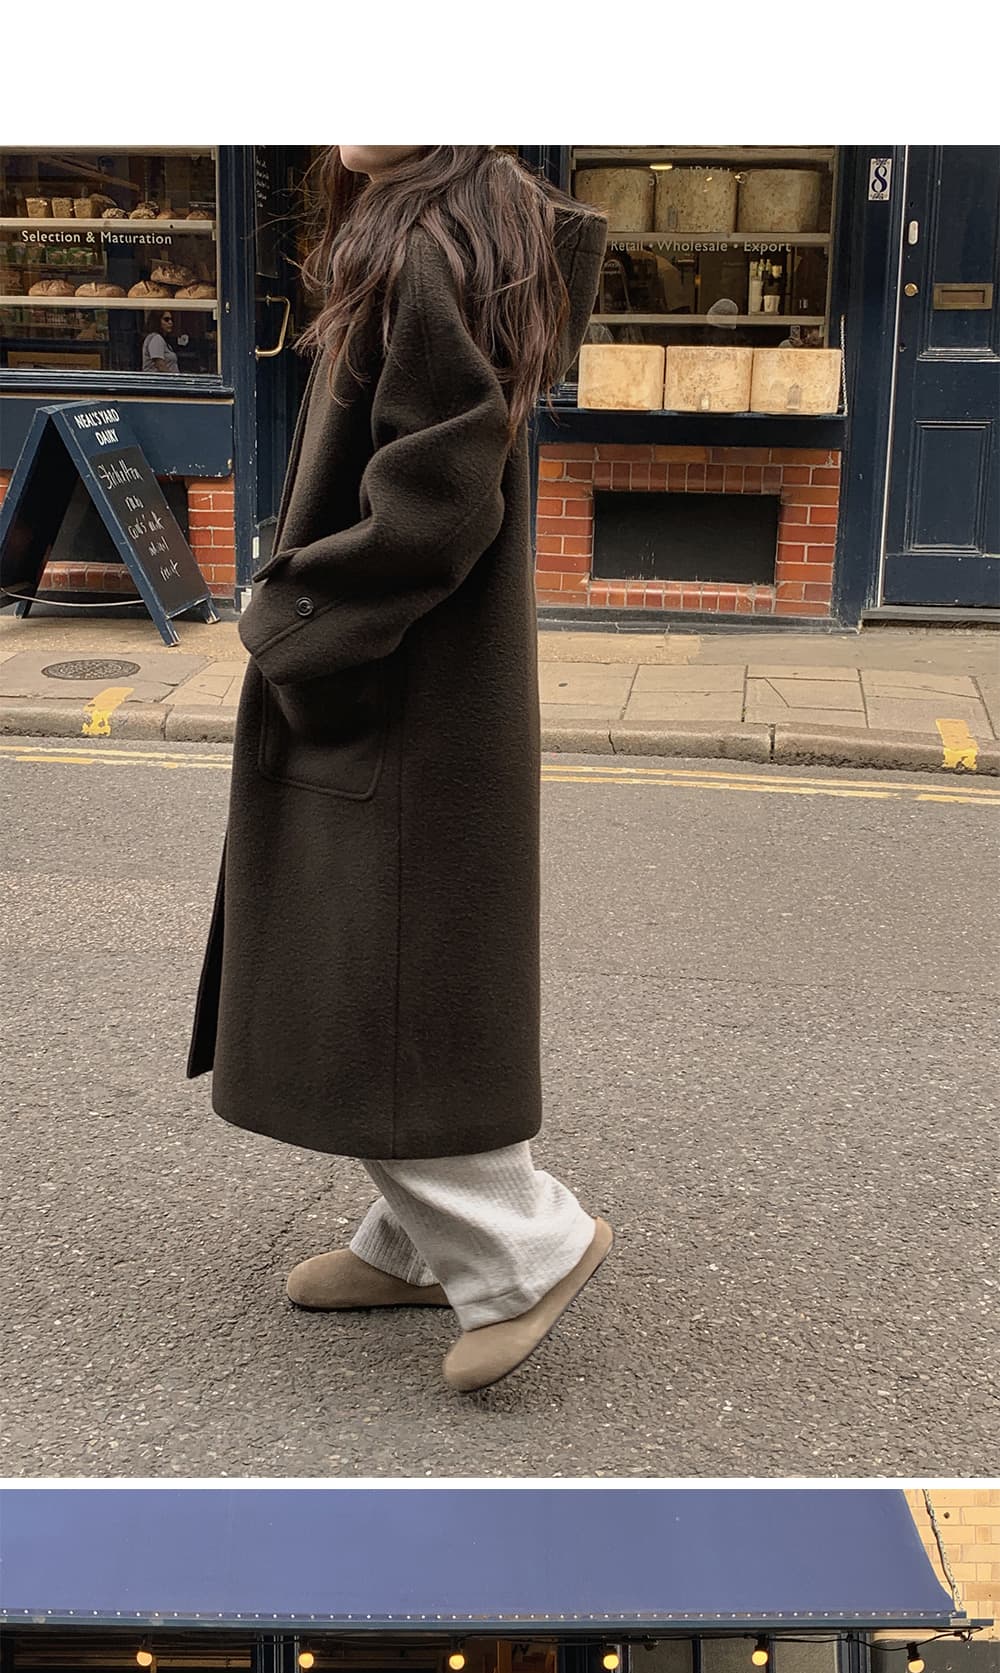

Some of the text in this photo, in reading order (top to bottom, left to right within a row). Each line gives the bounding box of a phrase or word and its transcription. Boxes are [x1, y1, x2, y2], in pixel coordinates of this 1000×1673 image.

[872, 166, 887, 192] 8
[21, 230, 173, 245] Selection & Maturation
[610, 240, 792, 255] Retail Wholesale Export
[74, 408, 120, 429] NEAL'S YARD
[95, 428, 119, 446] DAIRY
